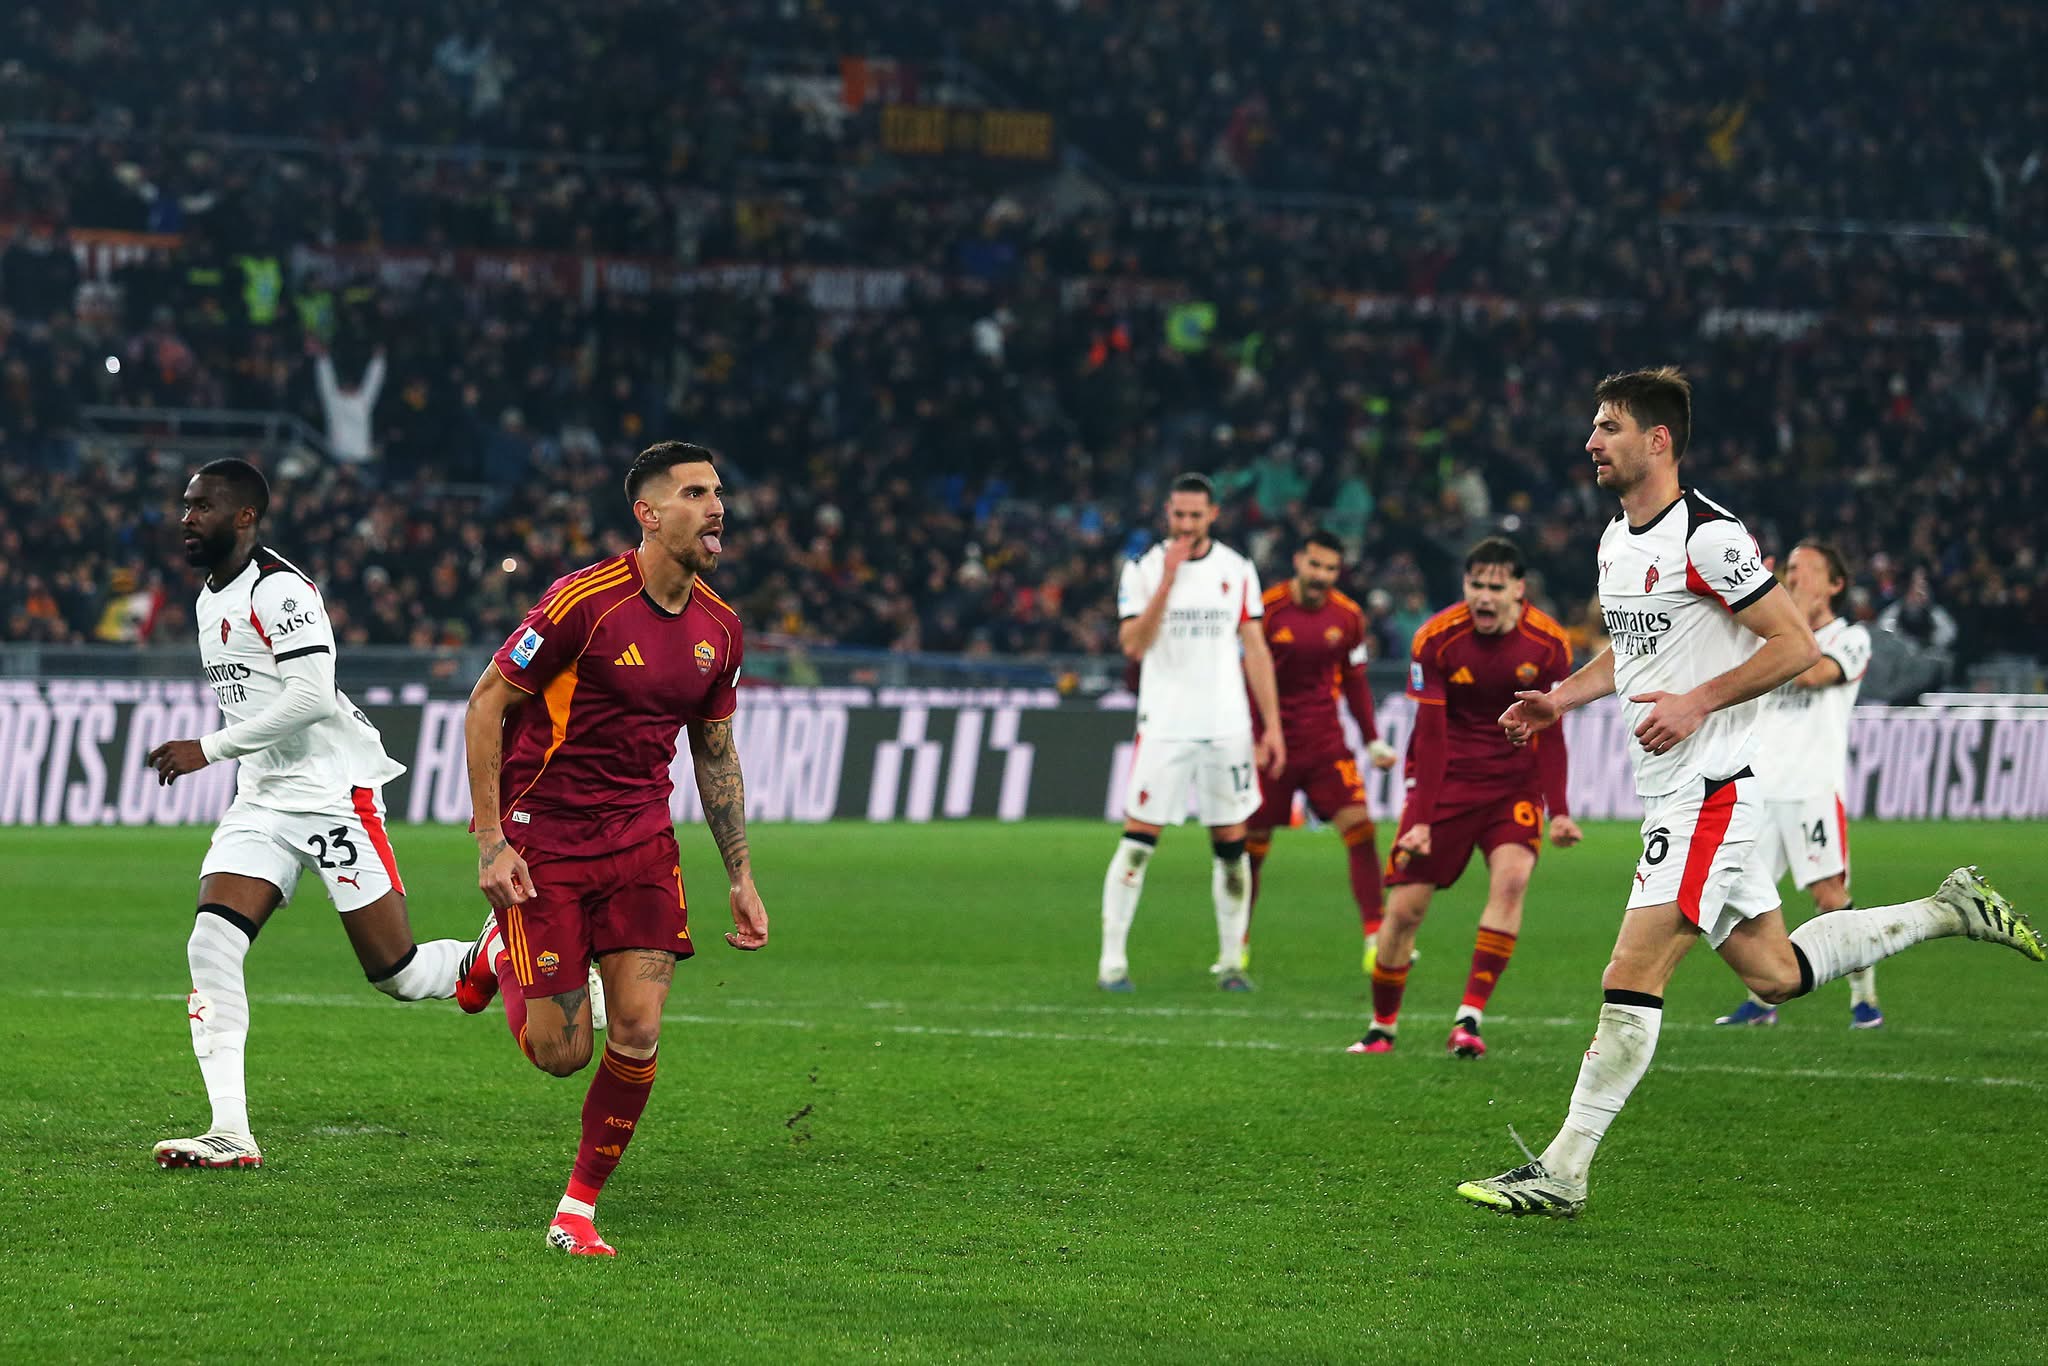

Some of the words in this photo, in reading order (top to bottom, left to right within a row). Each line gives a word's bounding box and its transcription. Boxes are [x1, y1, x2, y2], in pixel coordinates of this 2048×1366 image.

[1722, 556, 1760, 589] MSC
[276, 611, 317, 636] MSC
[308, 826, 358, 868] 23
[1645, 826, 1671, 865] 6
[1802, 818, 1827, 848] 14
[605, 1115, 633, 1130] ASR
